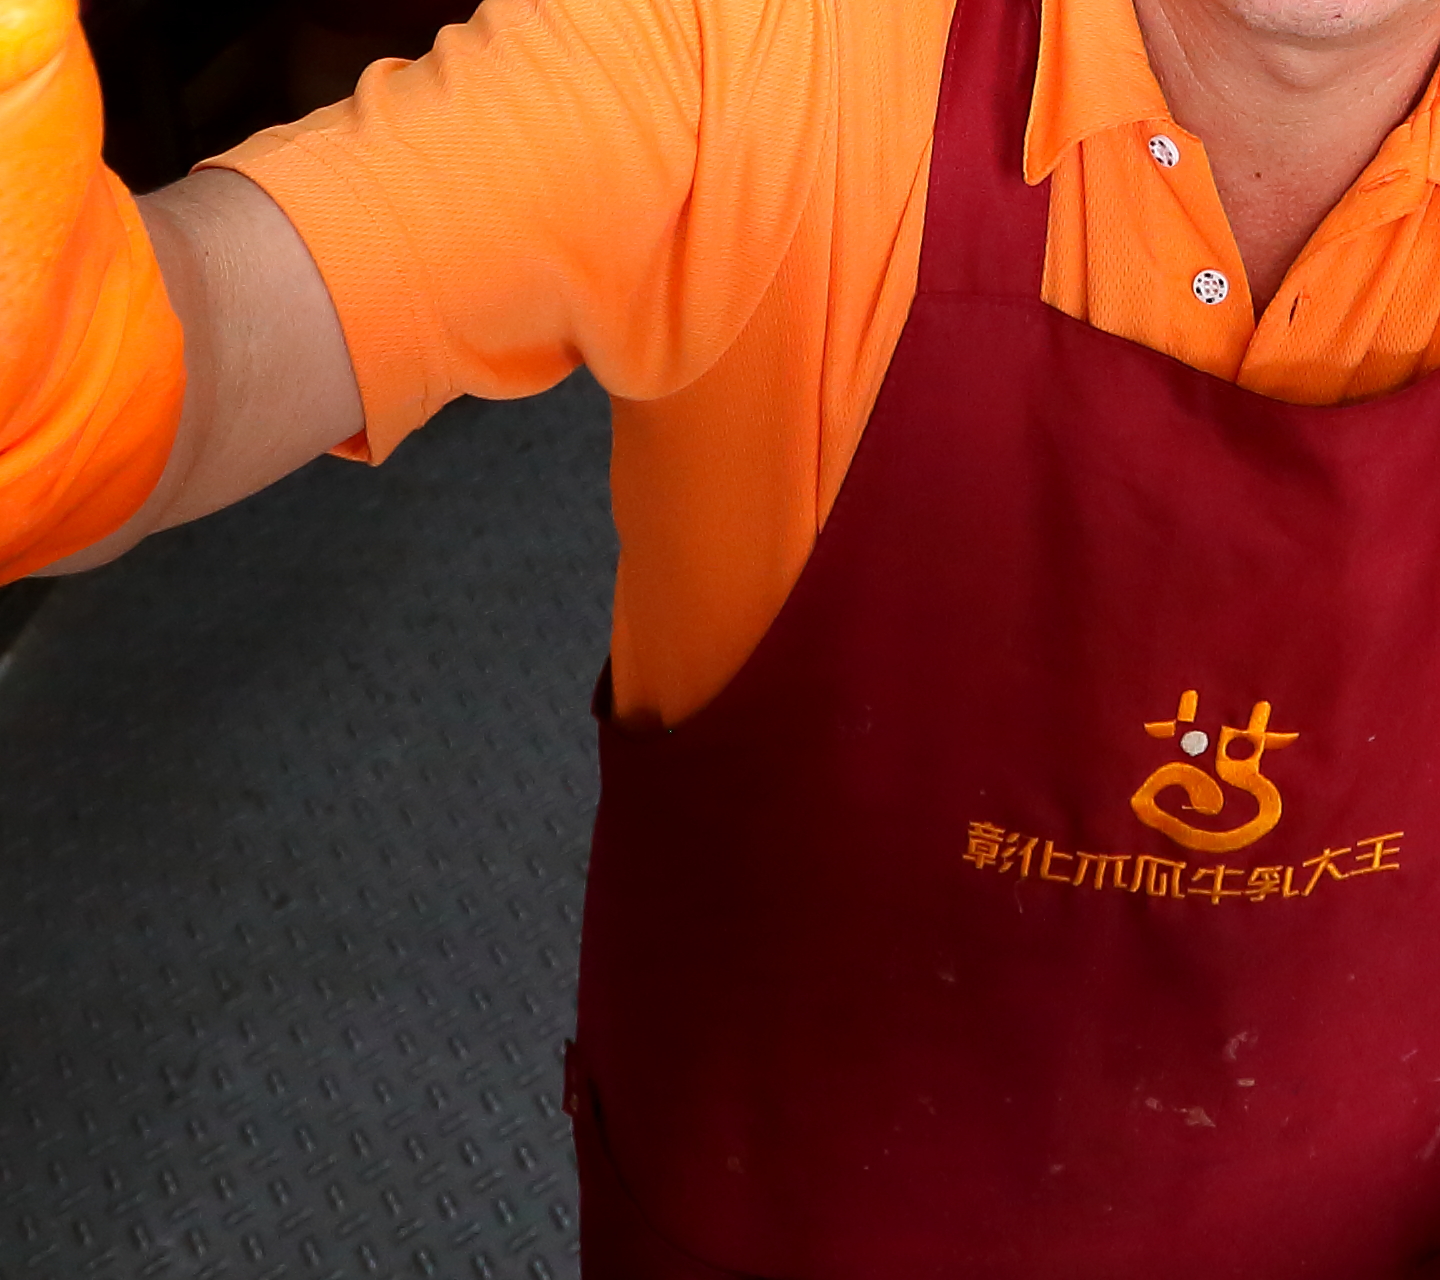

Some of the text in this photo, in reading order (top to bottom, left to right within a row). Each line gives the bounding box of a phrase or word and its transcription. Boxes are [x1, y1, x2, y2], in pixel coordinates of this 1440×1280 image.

[962, 830, 1405, 905] 彰化木瓜牛乳大王
